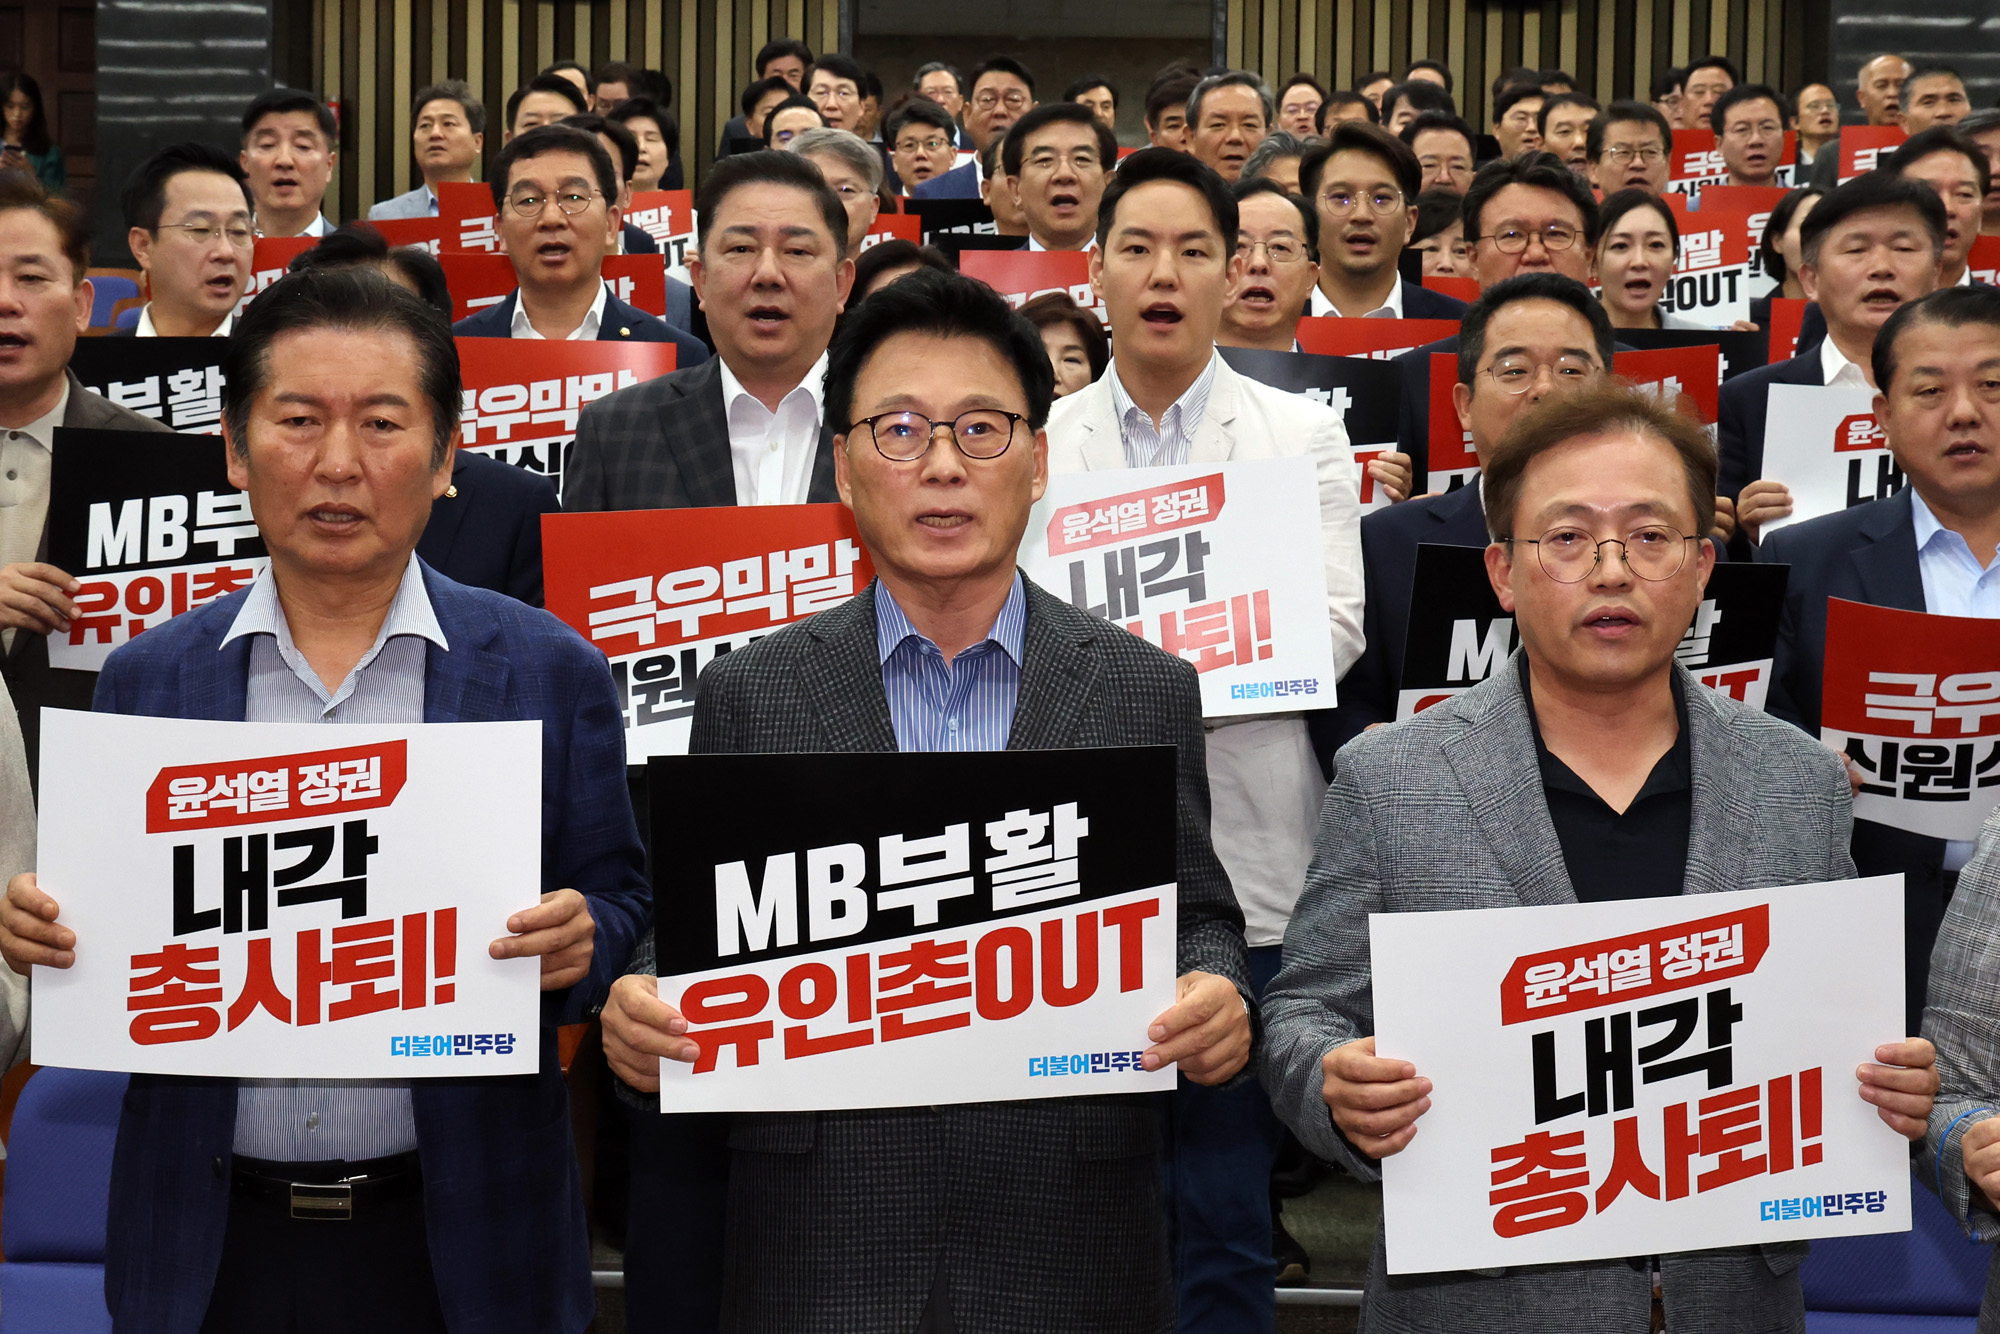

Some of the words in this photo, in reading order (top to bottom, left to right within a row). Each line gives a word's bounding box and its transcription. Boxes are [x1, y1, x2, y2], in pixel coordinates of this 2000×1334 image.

[85, 365, 226, 427] 부활
[1063, 499, 1147, 545] 윤석열
[1151, 485, 1209, 525] 정권
[588, 538, 860, 646] 극우막말
[1069, 530, 1210, 621] 내각
[1231, 679, 1319, 700] 더불어민주당
[167, 768, 290, 820] 윤석열
[297, 756, 382, 806] 정권
[172, 819, 378, 936] 내각
[714, 802, 1089, 957] MB부활
[127, 906, 457, 1046] 총사퇴!
[680, 898, 1160, 1075] 유인촌OUT
[1524, 943, 1651, 1009] 윤석열
[1660, 923, 1745, 980] 정권
[390, 1033, 516, 1057] 더불어민주당
[1531, 987, 1743, 1125] 내각
[1489, 1066, 1823, 1238] 총사퇴!
[1760, 1190, 1887, 1221] 더불어민주당
